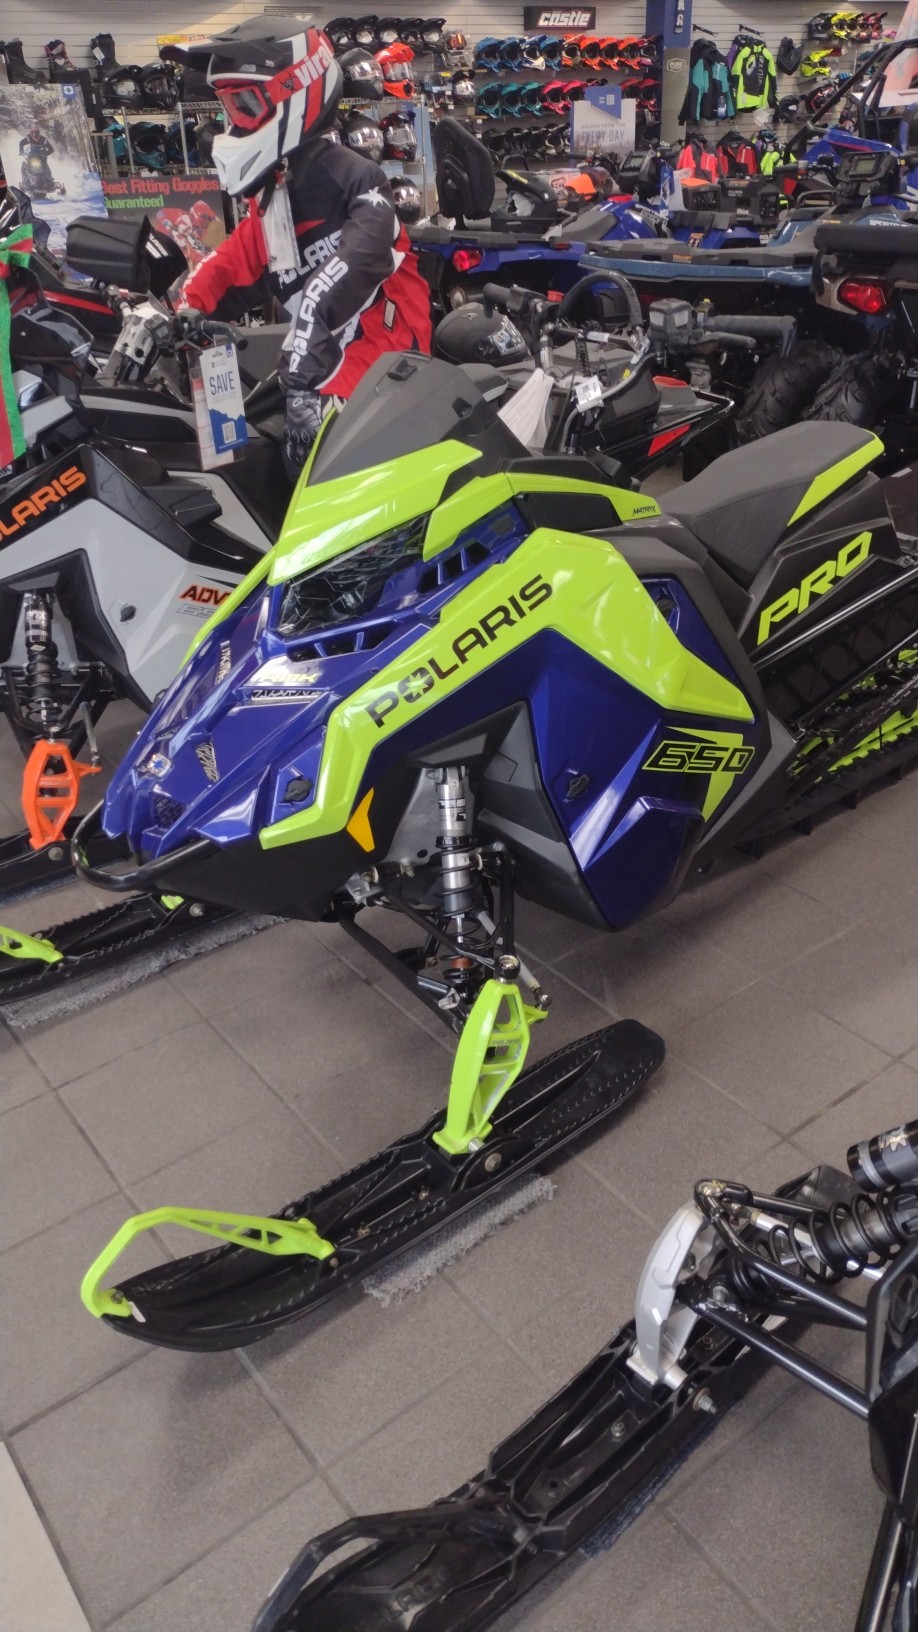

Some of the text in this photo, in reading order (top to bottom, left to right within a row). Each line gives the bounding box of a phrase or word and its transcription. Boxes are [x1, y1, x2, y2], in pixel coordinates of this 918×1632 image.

[294, 42, 334, 88] viral
[609, 129, 625, 142] DAY
[130, 178, 170, 195] Fitting
[171, 176, 218, 194] Goggles
[278, 229, 342, 289] OLARIS
[288, 256, 349, 374] POLARIS
[209, 371, 236, 396] SAVE
[0, 466, 87, 542] LARIS
[632, 505, 656, 516] MATRYX
[757, 531, 872, 646] PRO
[364, 574, 553, 729] POLARIS
[642, 740, 755, 774] 650
